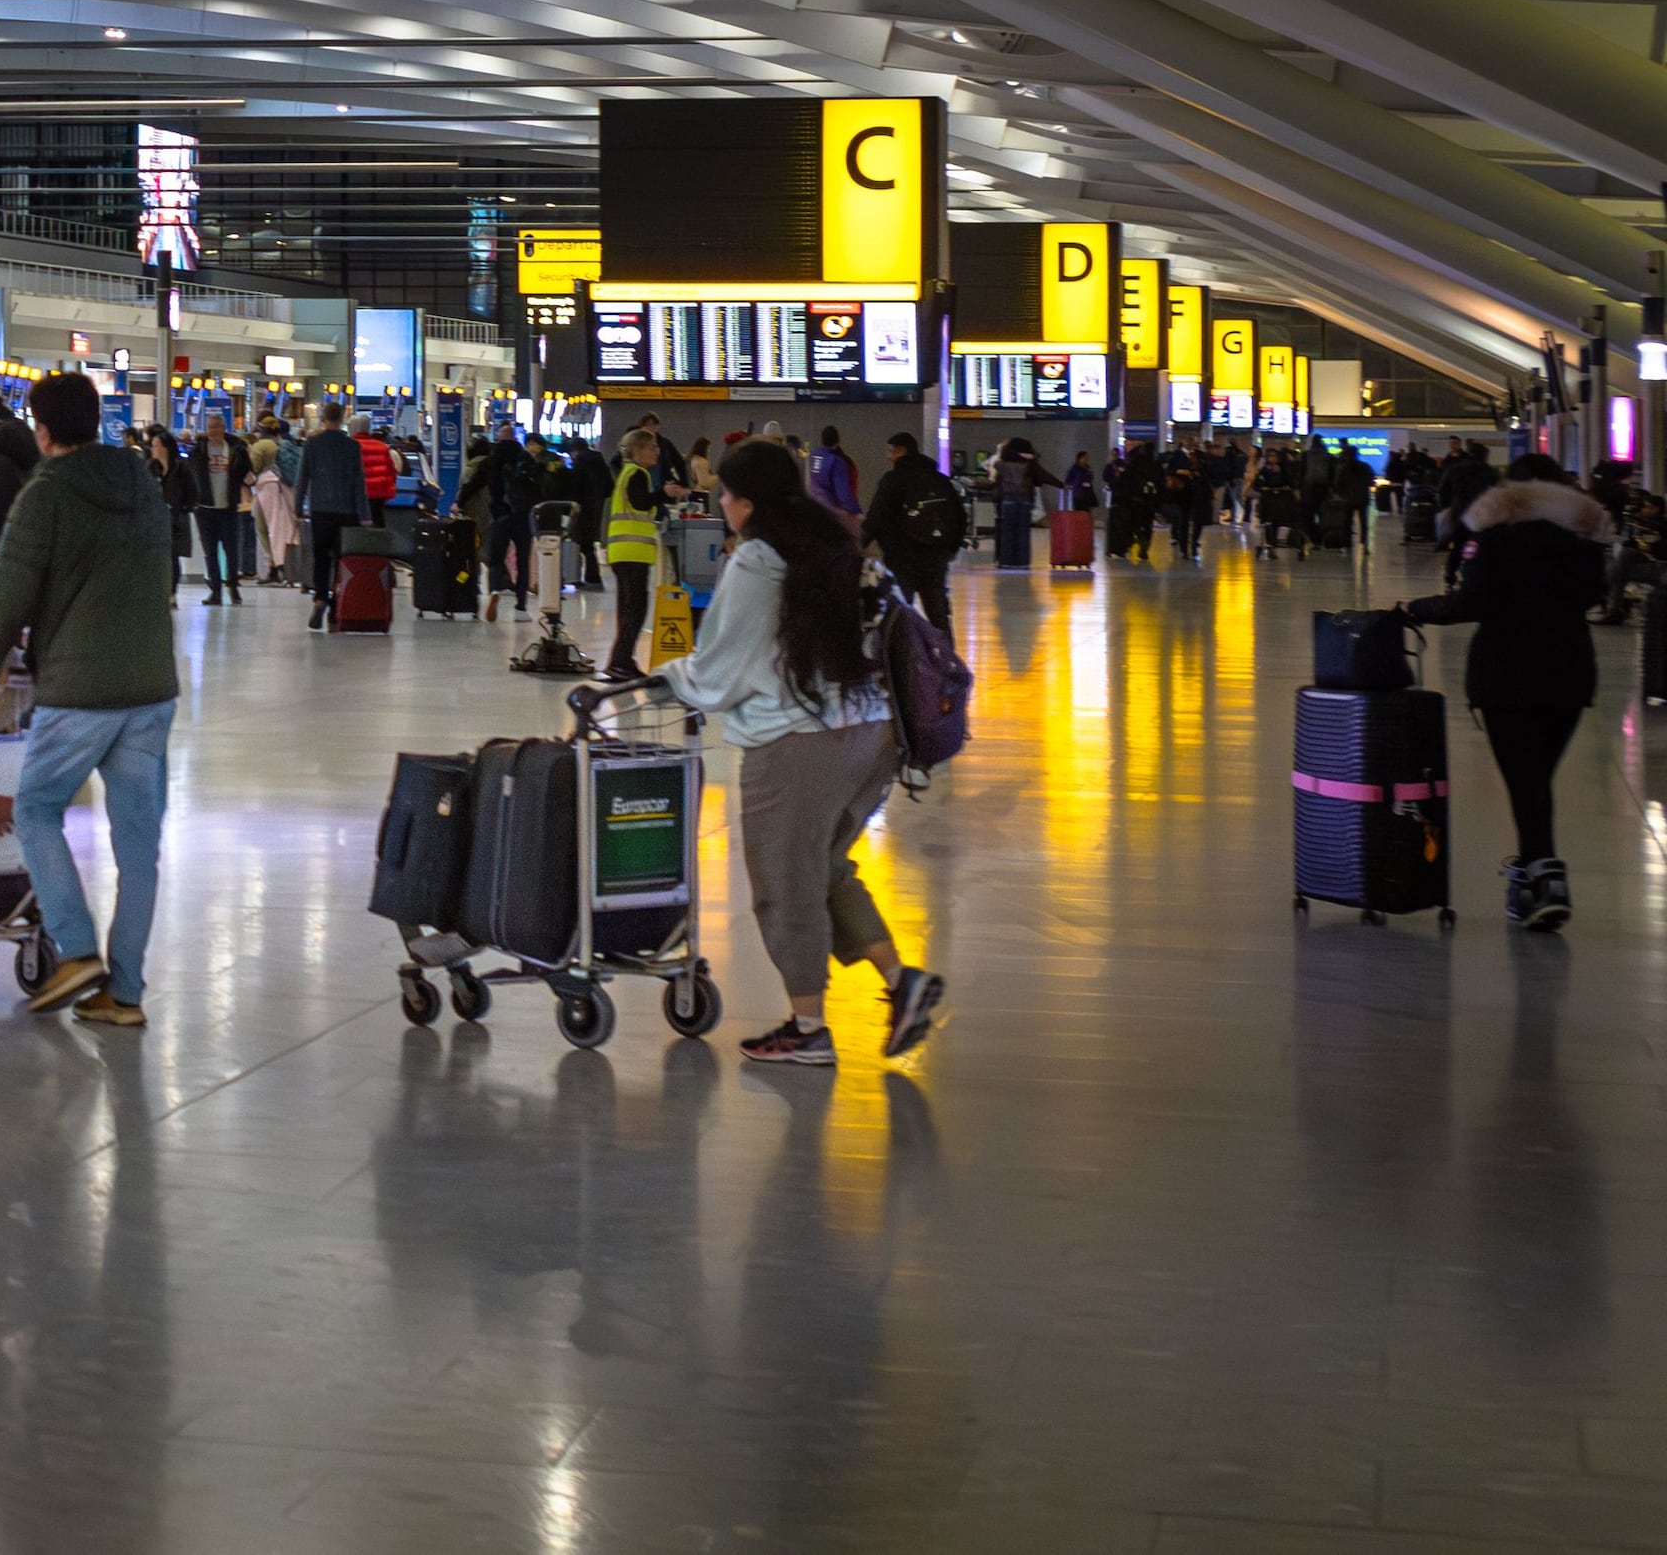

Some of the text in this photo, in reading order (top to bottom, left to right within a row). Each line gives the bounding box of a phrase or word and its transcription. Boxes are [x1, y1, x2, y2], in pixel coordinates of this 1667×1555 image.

[846, 126, 895, 189] C
[1058, 242, 1092, 282] D
[1222, 331, 1243, 354] G
[1269, 355, 1285, 374] H
[611, 796, 670, 815] Europcar
